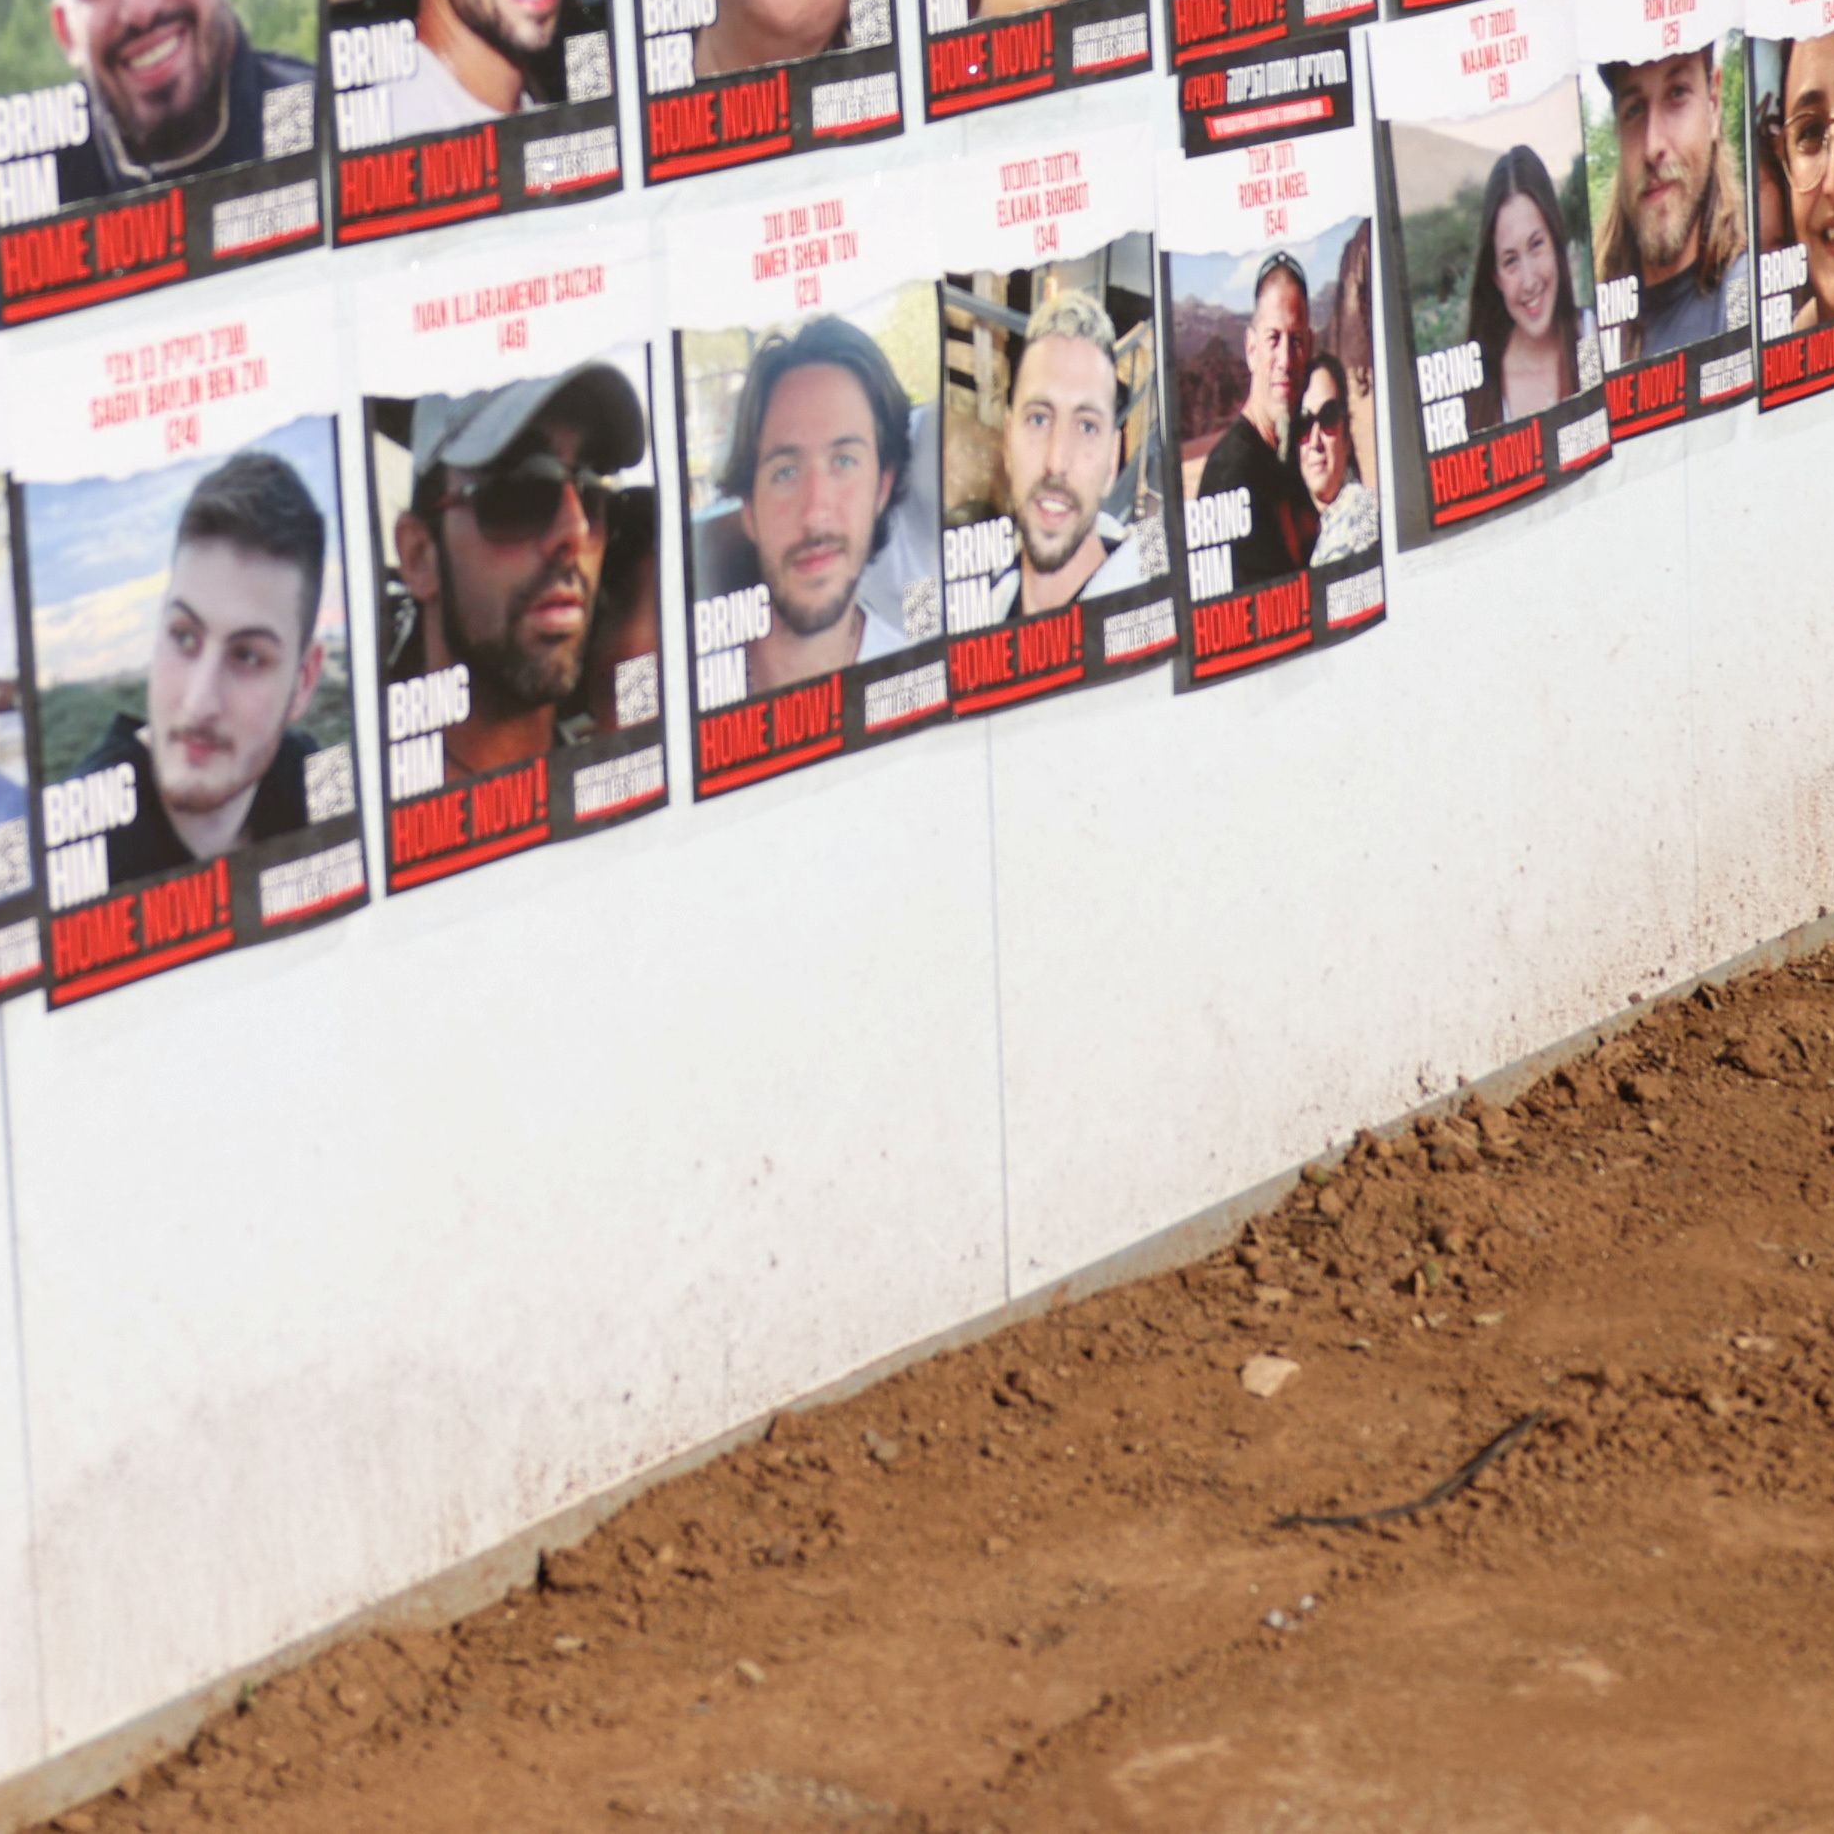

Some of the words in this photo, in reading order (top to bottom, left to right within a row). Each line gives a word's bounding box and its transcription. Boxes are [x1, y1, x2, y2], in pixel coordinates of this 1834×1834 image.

[646, 36, 695, 94] HER
[649, 96, 718, 156] HOME
[722, 70, 789, 140] NOW!
[0, 219, 90, 296] HOME
[96, 188, 186, 278] NOW!
[1417, 343, 1483, 401] BRING
[1423, 399, 1468, 452] HER
[1430, 453, 1487, 504] HOME
[1492, 418, 1541, 486] NOW!
[389, 664, 470, 737] BRING
[391, 733, 444, 798] HIM
[392, 795, 468, 865] HOME
[472, 759, 549, 837] NOW!
